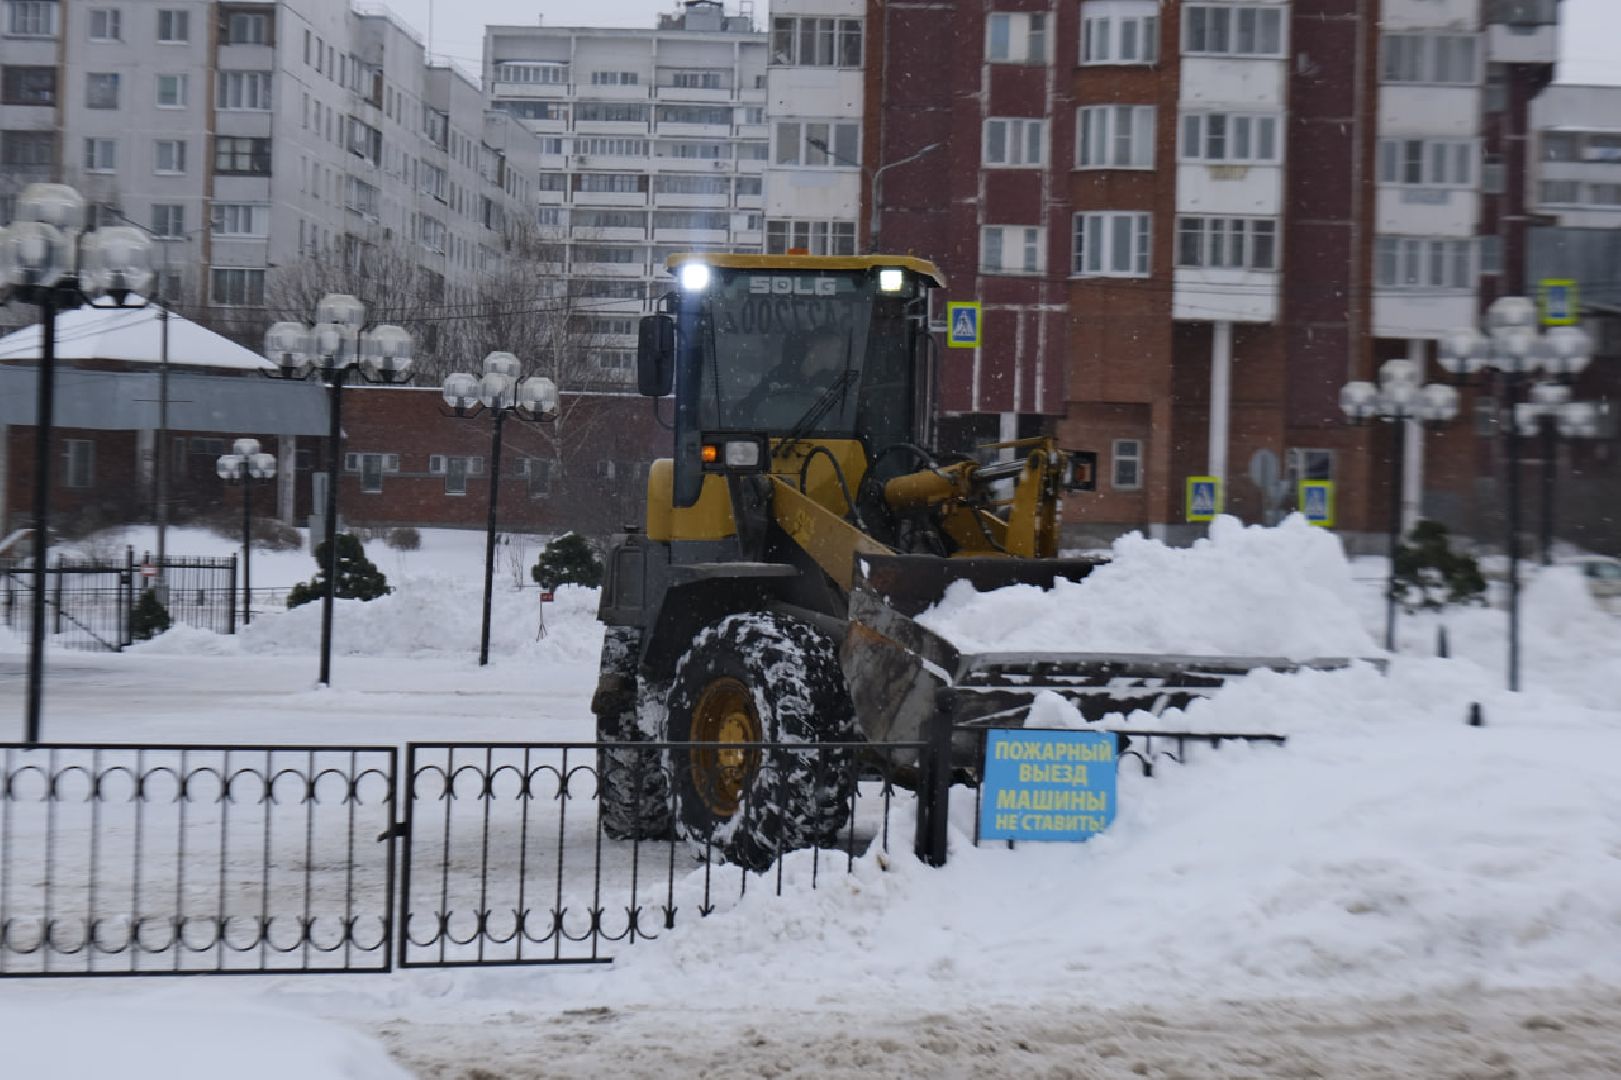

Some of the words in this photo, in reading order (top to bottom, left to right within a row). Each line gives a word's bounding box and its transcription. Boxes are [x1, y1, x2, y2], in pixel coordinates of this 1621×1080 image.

[995, 740, 1112, 761] ПОЖАРНЫЙ
[1019, 764, 1088, 785] ВЫЕЗД
[996, 790, 1105, 810] МАШИНЫ
[995, 814, 1018, 830] НЕ
